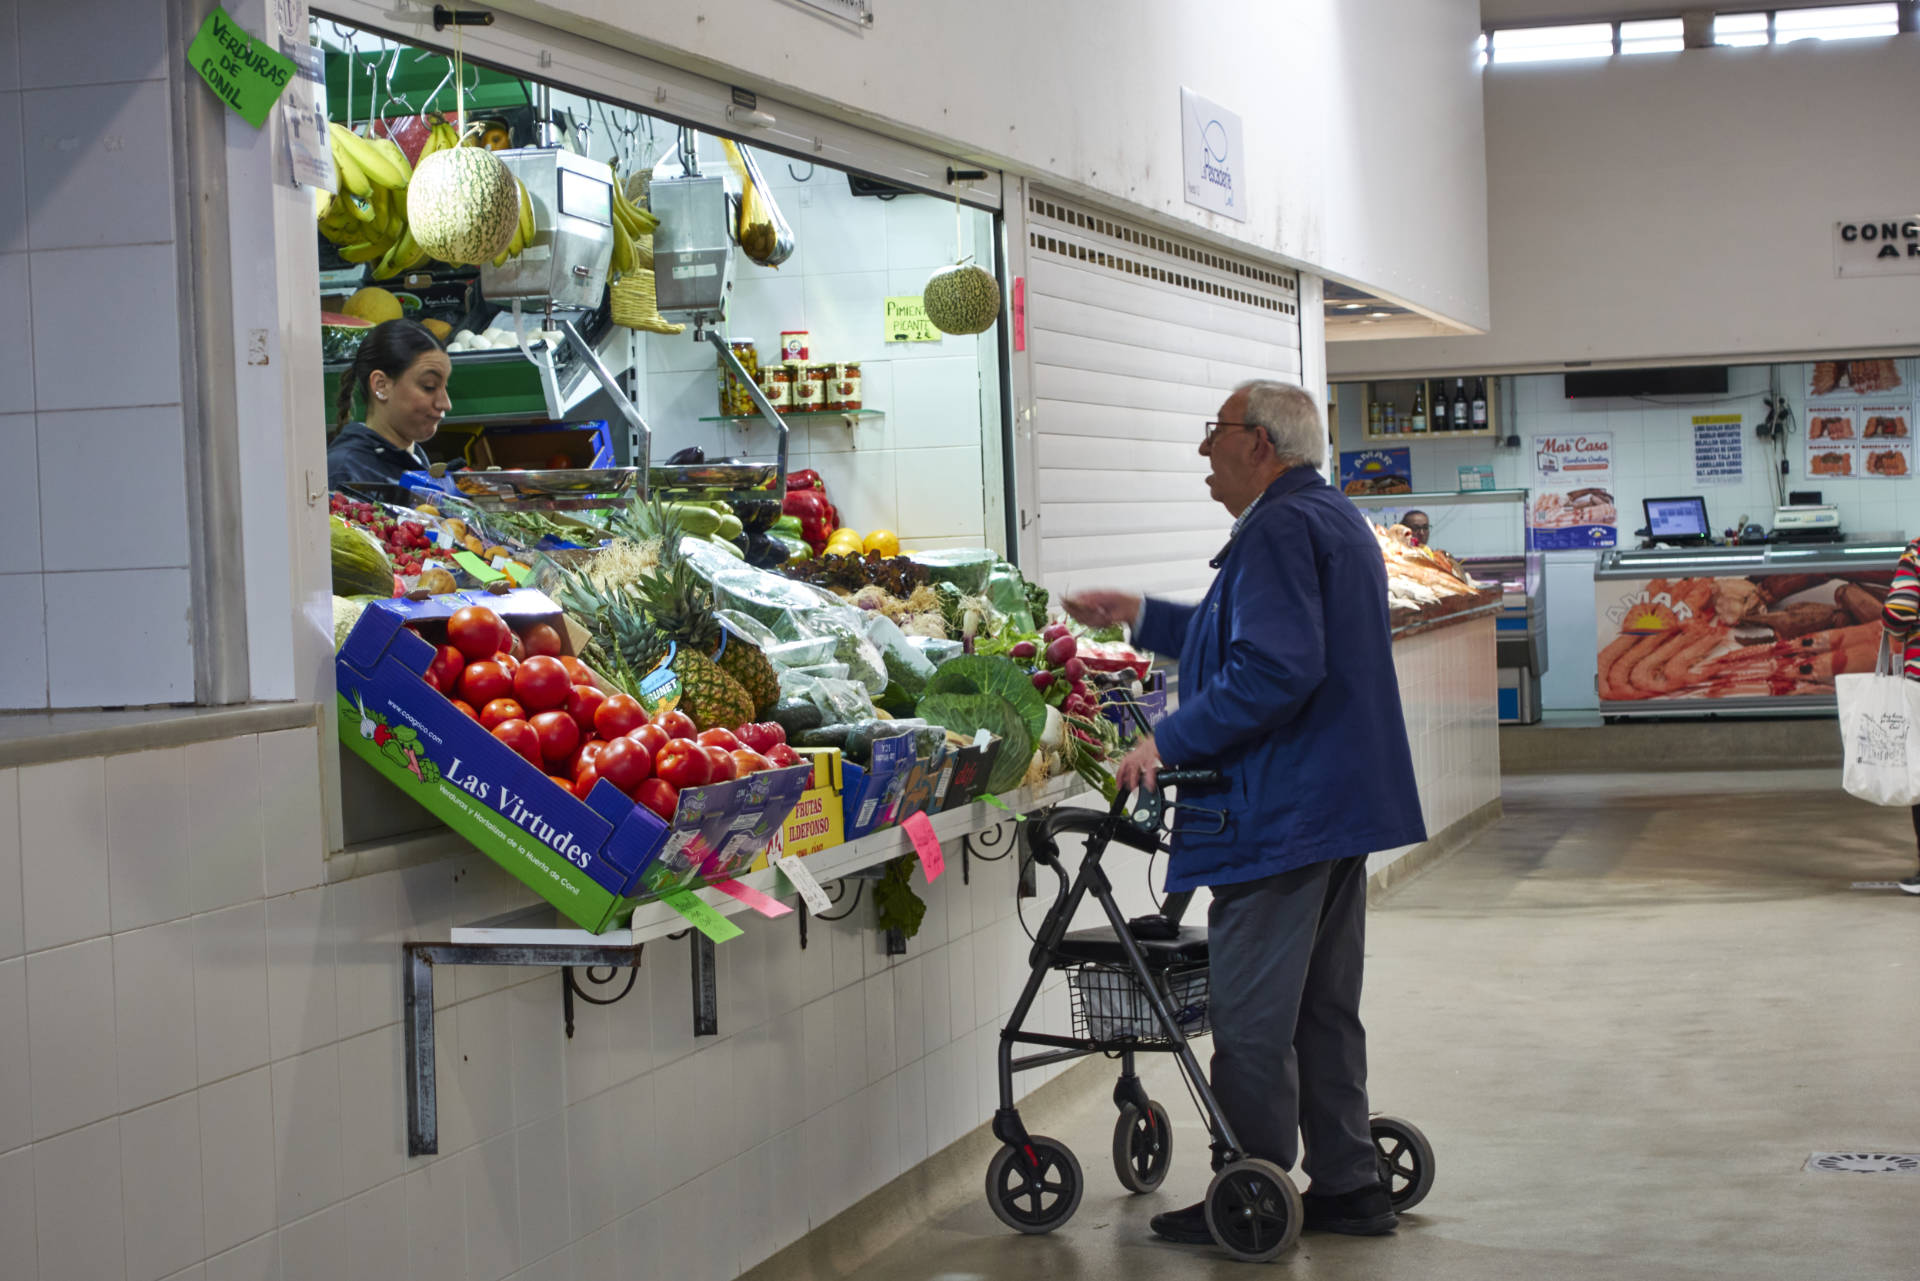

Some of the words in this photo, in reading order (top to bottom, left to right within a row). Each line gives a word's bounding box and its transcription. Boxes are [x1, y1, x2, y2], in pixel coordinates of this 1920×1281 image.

[213, 16, 287, 86] VERDURAS
[220, 55, 242, 77] DE
[201, 58, 242, 110] CONIL
[1354, 451, 1393, 468] AMAR
[1540, 438, 1571, 454] Mar
[1575, 436, 1609, 453] Casa
[1606, 591, 1694, 625] AMAR
[445, 756, 491, 799] Las
[499, 785, 592, 869] Virtudes
[795, 798, 823, 819] FRUTAS
[439, 784, 469, 811] Verduras
[467, 807, 475, 815] y
[473, 811, 507, 840] Hortalizas
[506, 837, 518, 848] de
[517, 845, 527, 854] la
[525, 850, 550, 872] Huerta
[549, 870, 561, 880] de
[560, 878, 581, 896] Conil
[789, 817, 830, 842] ILDEFONSO
